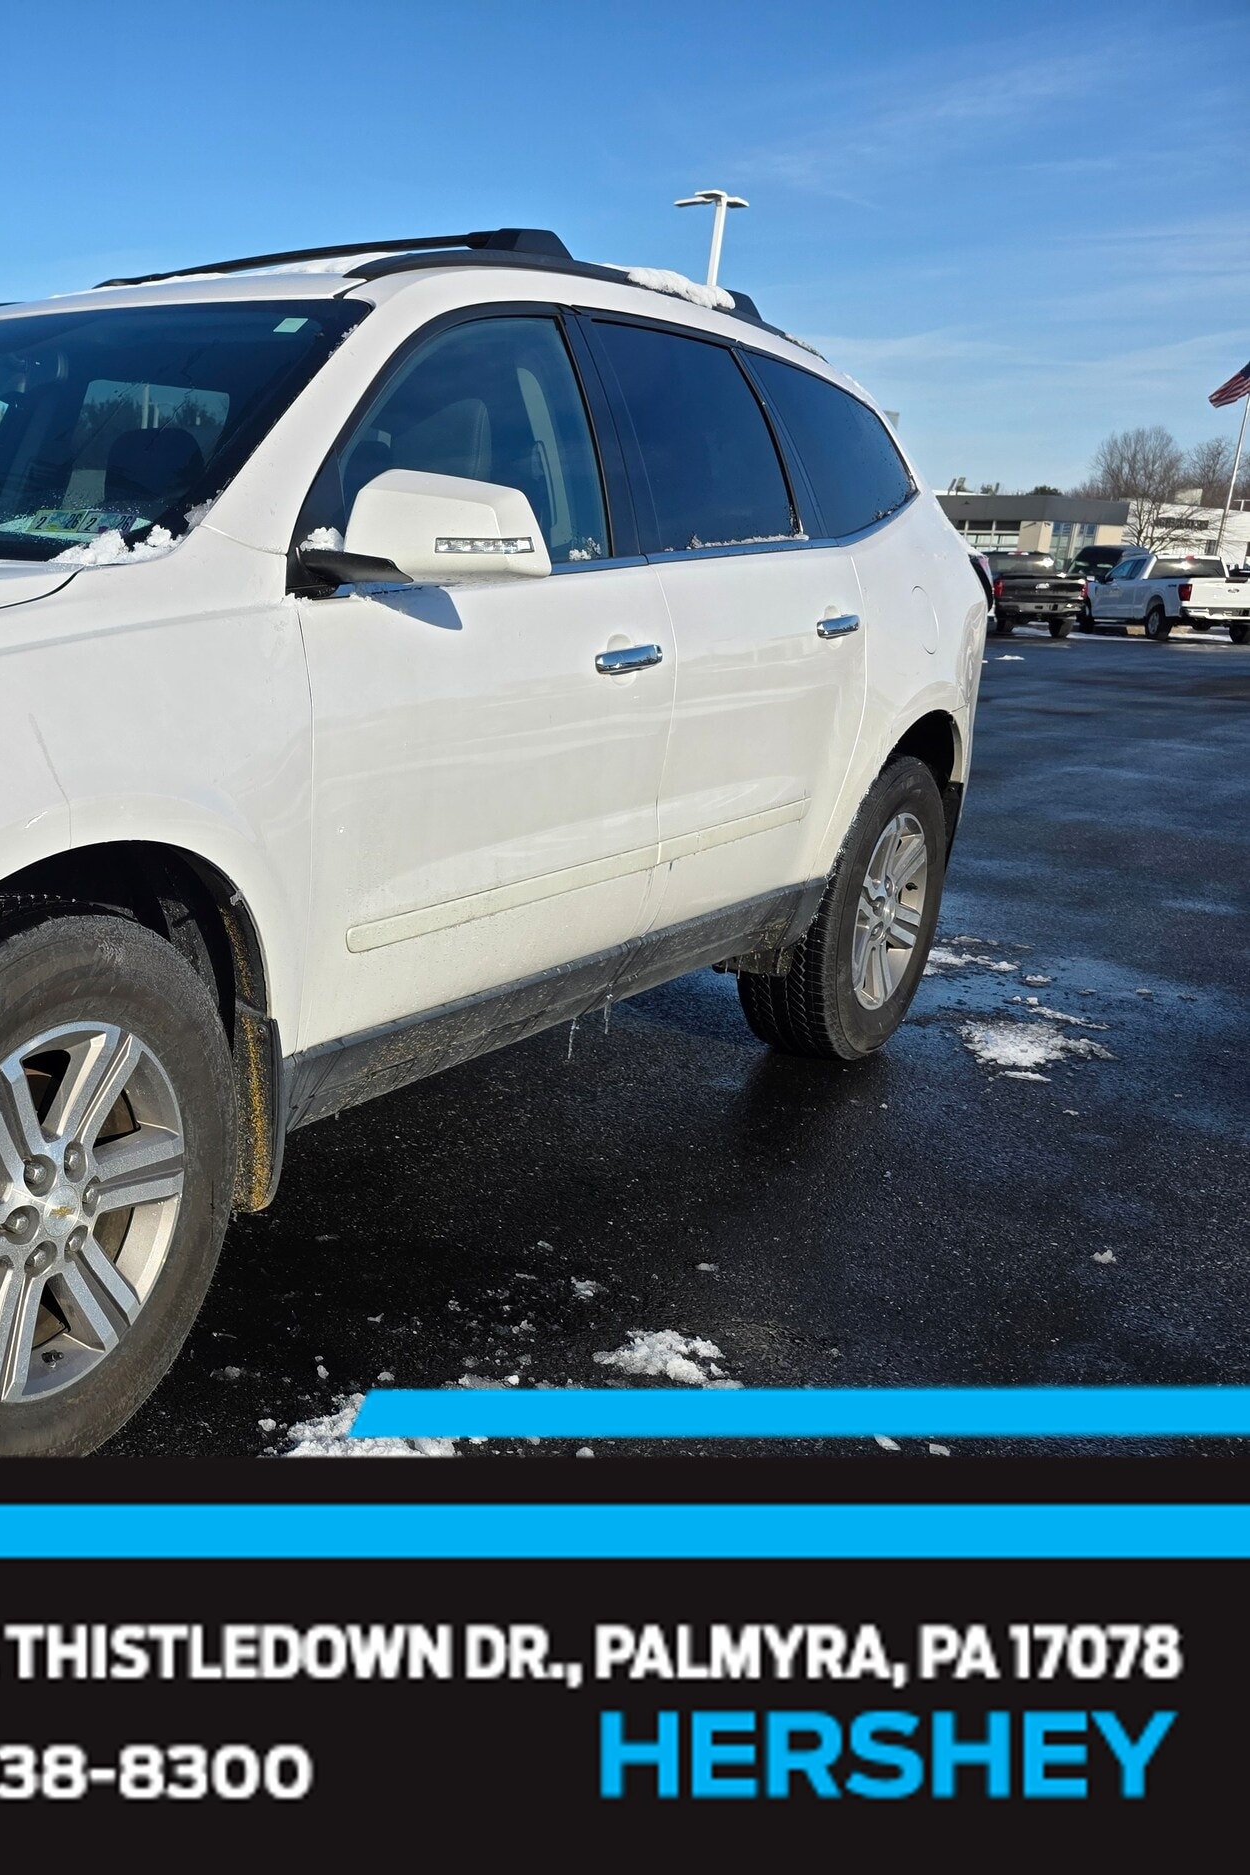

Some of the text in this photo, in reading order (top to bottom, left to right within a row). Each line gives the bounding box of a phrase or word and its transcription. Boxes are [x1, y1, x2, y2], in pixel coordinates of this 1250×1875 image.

[34, 513, 83, 530] 2 26
[84, 517, 98, 531] 2
